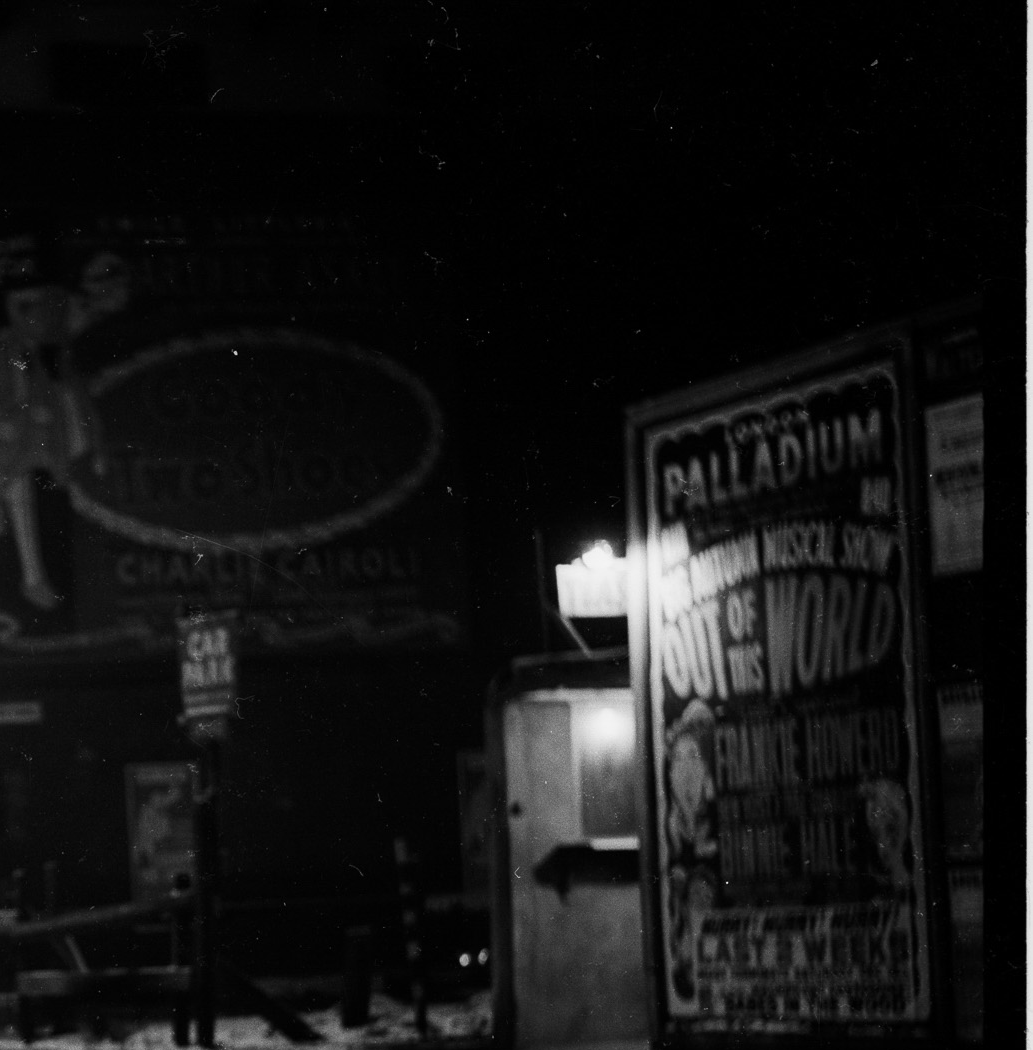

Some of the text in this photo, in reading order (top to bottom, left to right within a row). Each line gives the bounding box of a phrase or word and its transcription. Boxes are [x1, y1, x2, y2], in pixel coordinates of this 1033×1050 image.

[662, 408, 884, 518] PALLADIUM
[838, 521, 897, 577] SHOW
[660, 598, 729, 700] OUT
[725, 588, 759, 642] OF
[764, 570, 897, 703] WORLD
[714, 717, 801, 792] FRANKIE
